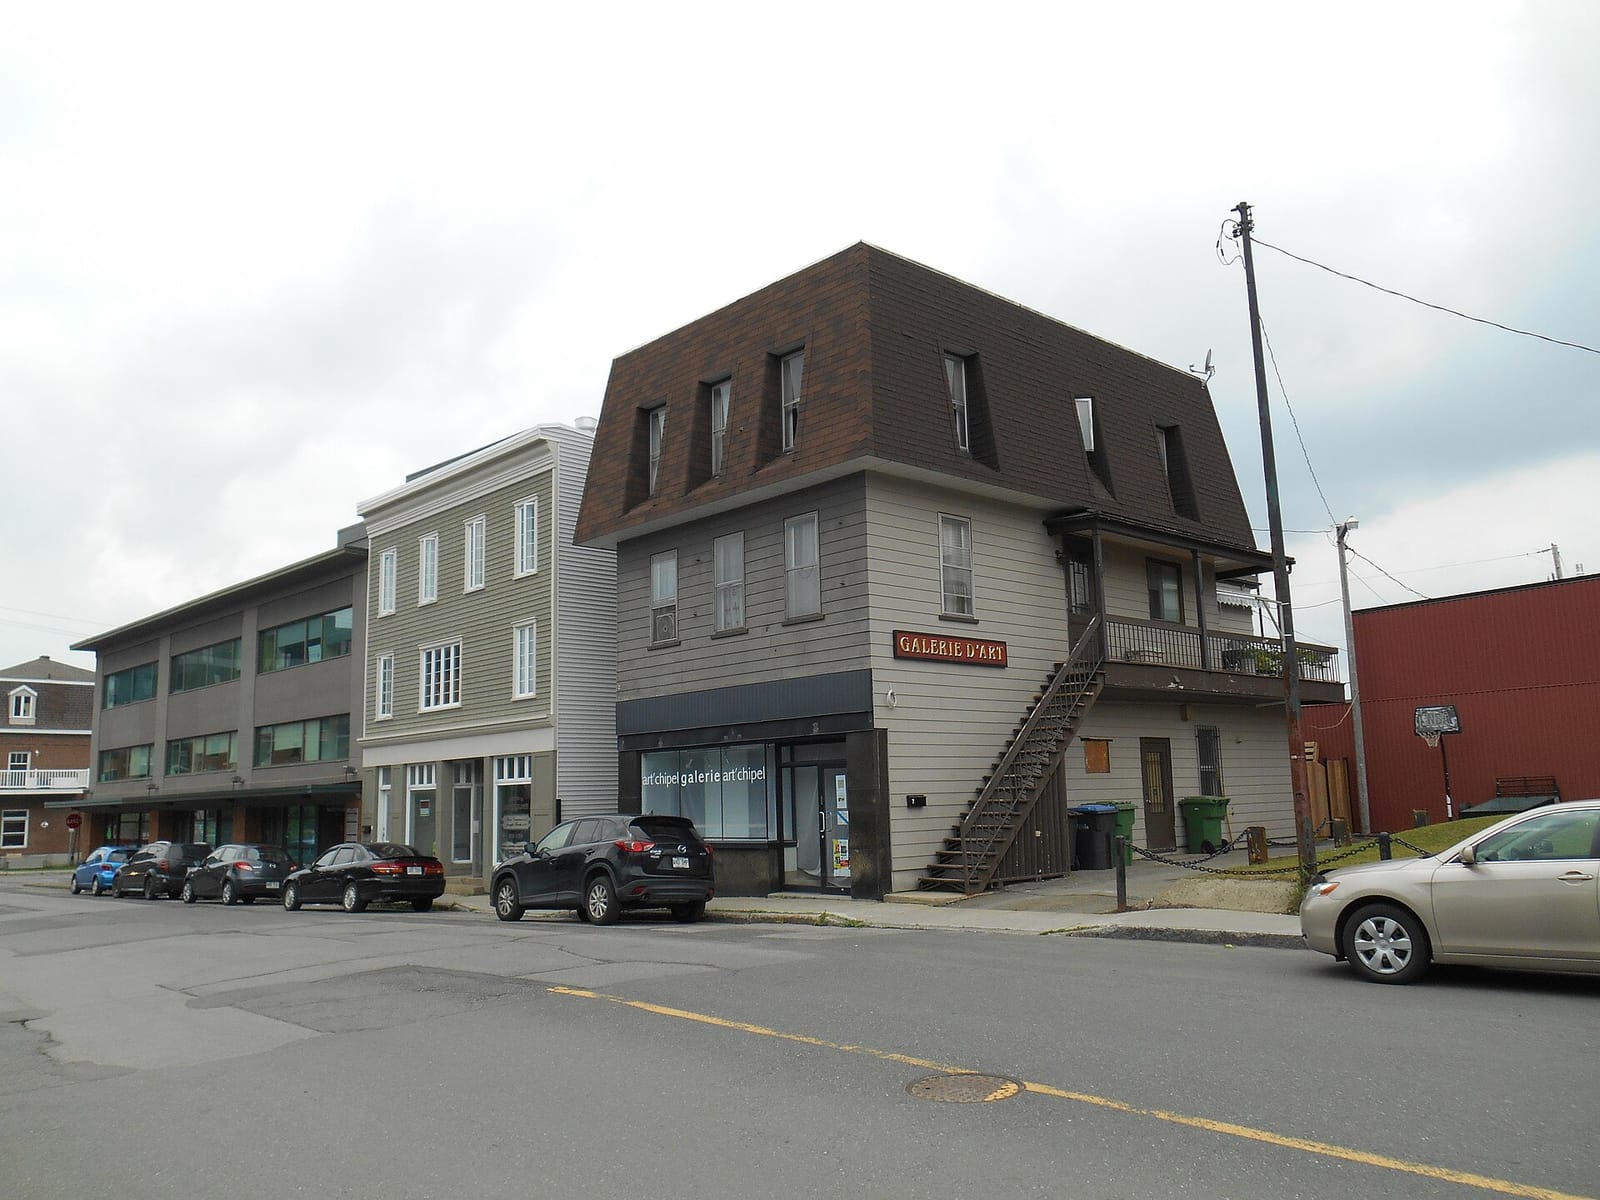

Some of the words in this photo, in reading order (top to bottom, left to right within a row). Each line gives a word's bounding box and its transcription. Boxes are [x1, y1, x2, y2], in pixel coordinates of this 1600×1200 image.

[900, 636, 962, 657] GALERIE
[966, 643, 1004, 660] D'ART
[681, 769, 720, 787] galerie
[722, 766, 765, 783] art'chipel
